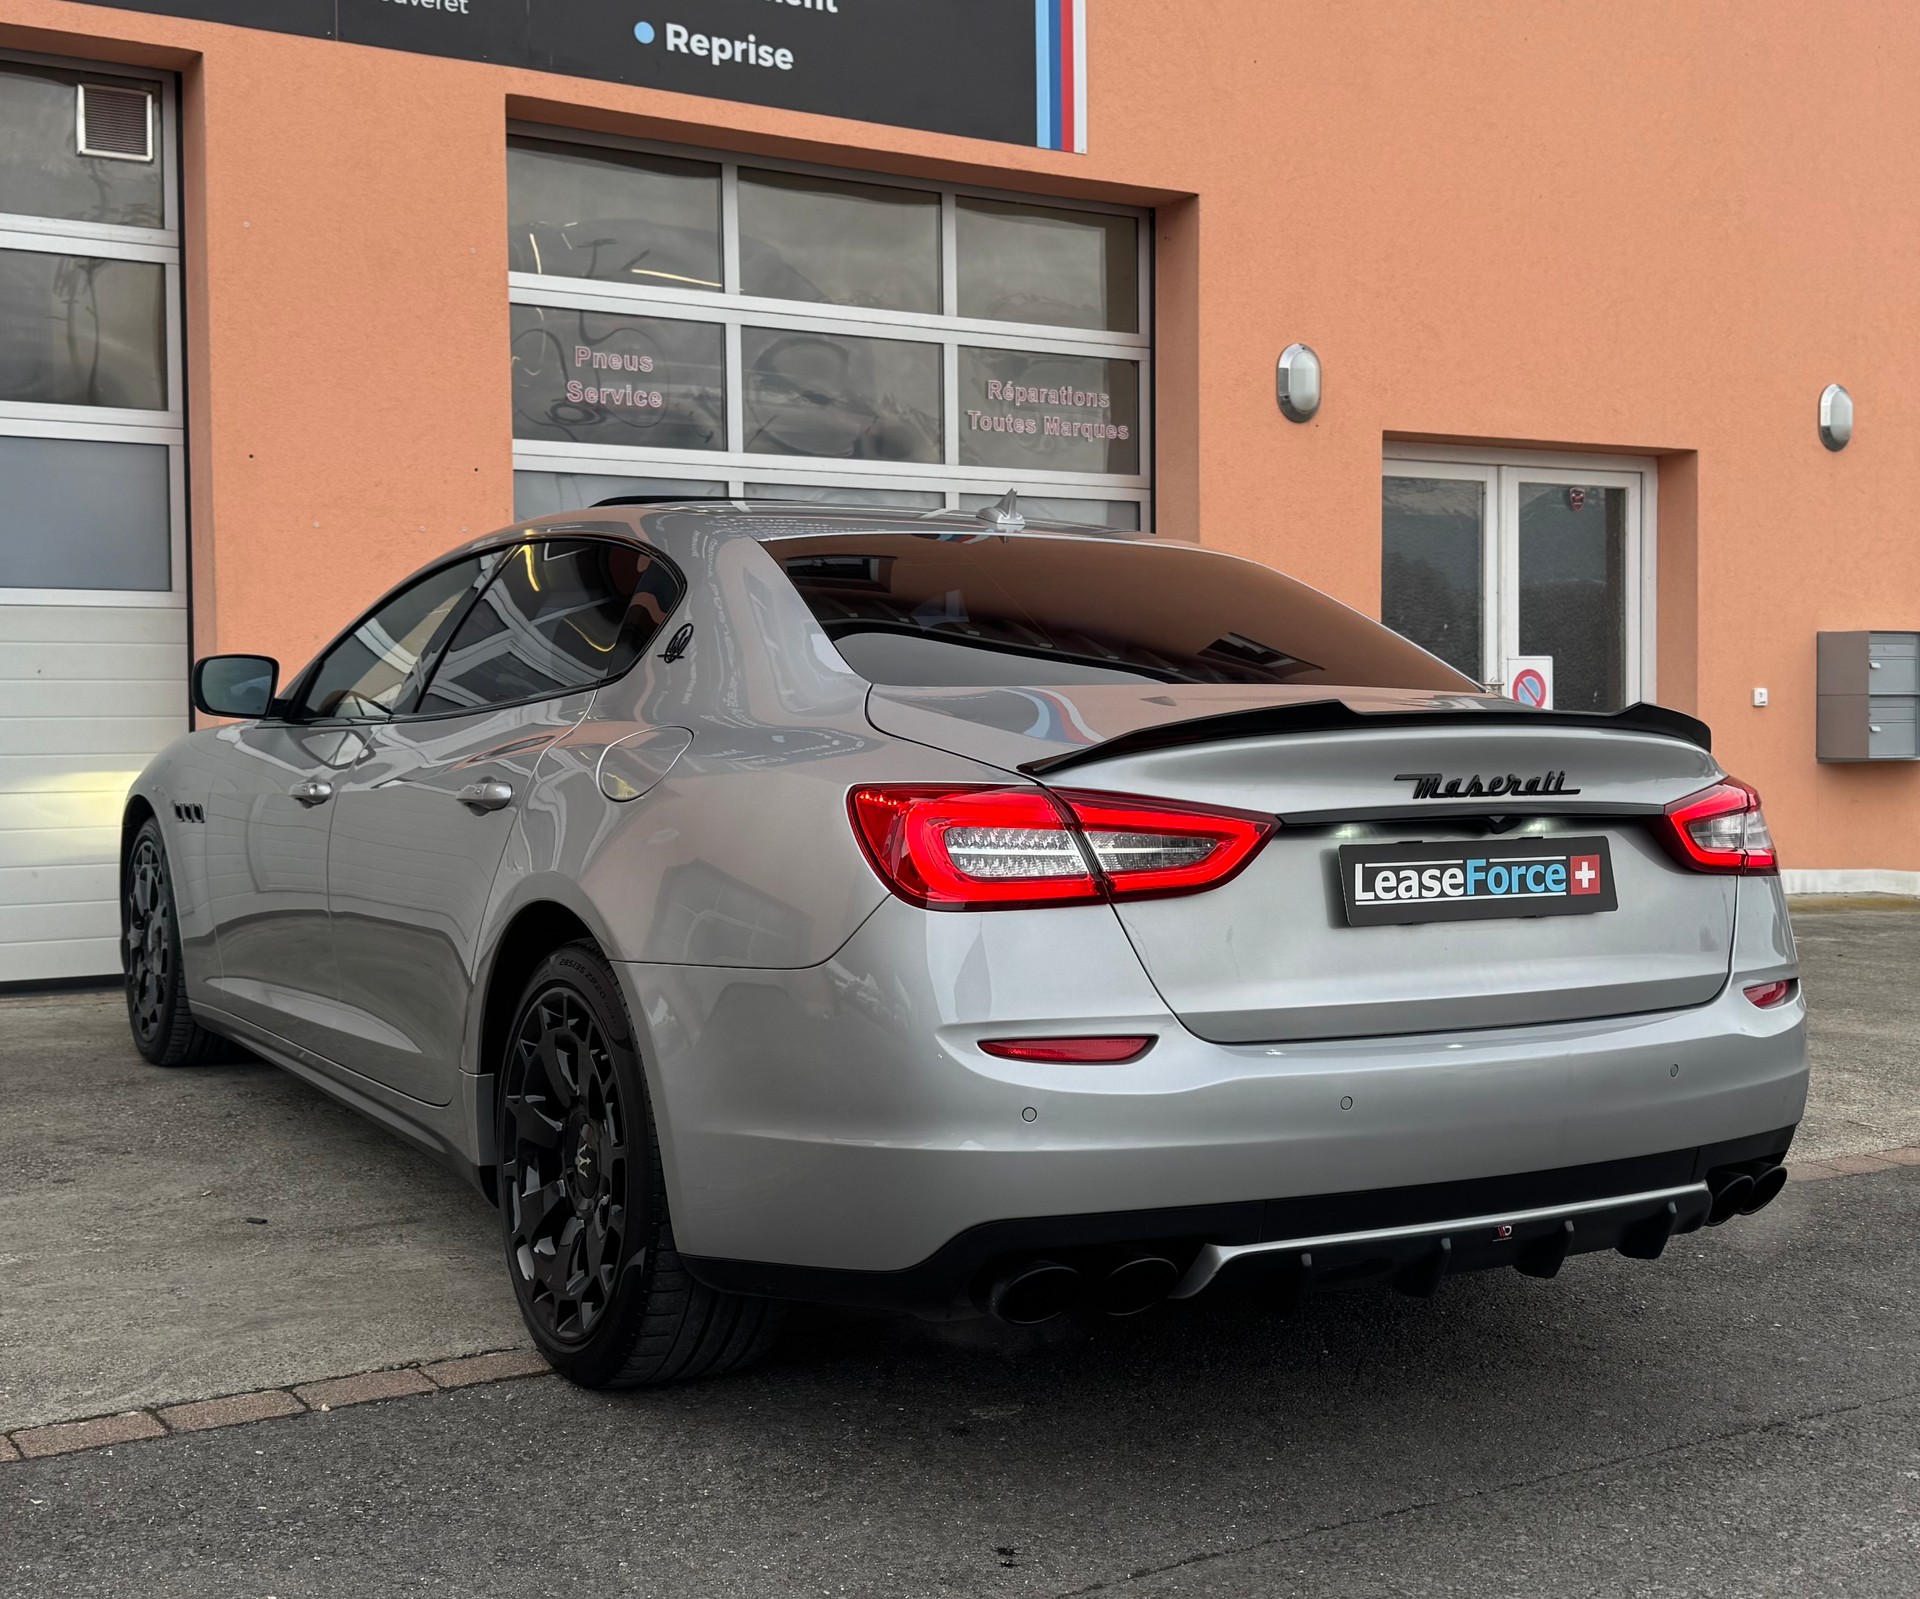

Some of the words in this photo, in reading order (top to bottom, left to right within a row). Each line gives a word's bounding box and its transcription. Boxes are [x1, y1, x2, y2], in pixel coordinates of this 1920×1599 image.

[381, 0, 469, 14] eret
[665, 22, 794, 70] Reprise
[575, 346, 653, 372] Pneus
[566, 380, 662, 408] Service
[987, 380, 1110, 408] Réparations
[967, 410, 1037, 434] Toutes
[1043, 415, 1129, 442] Marques
[1394, 770, 1581, 799] Maserati
[1354, 859, 1567, 900] LeaseForce
